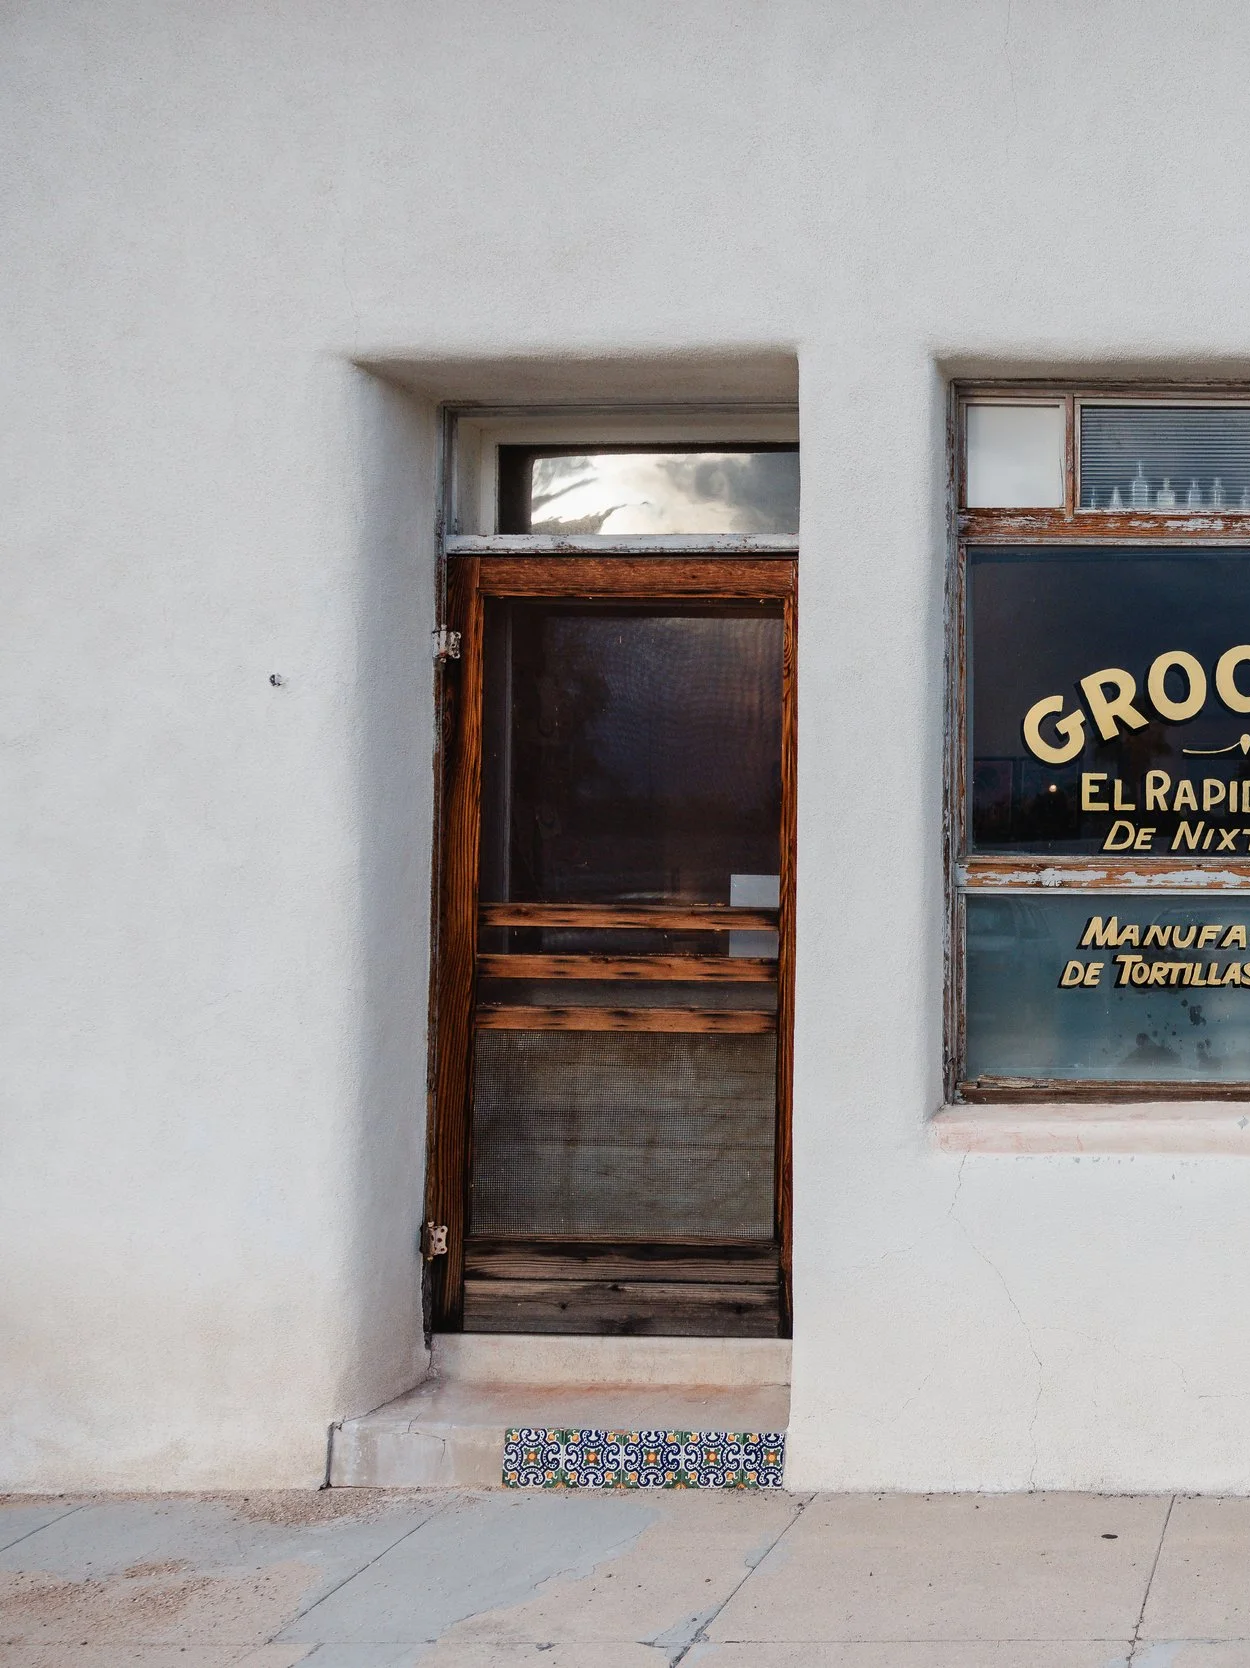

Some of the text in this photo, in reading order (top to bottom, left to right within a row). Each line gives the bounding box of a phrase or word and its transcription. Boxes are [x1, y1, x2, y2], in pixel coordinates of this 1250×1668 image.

[1081, 772, 1136, 811] EL
[1103, 820, 1155, 850] DE
[1063, 960, 1104, 985] DE
